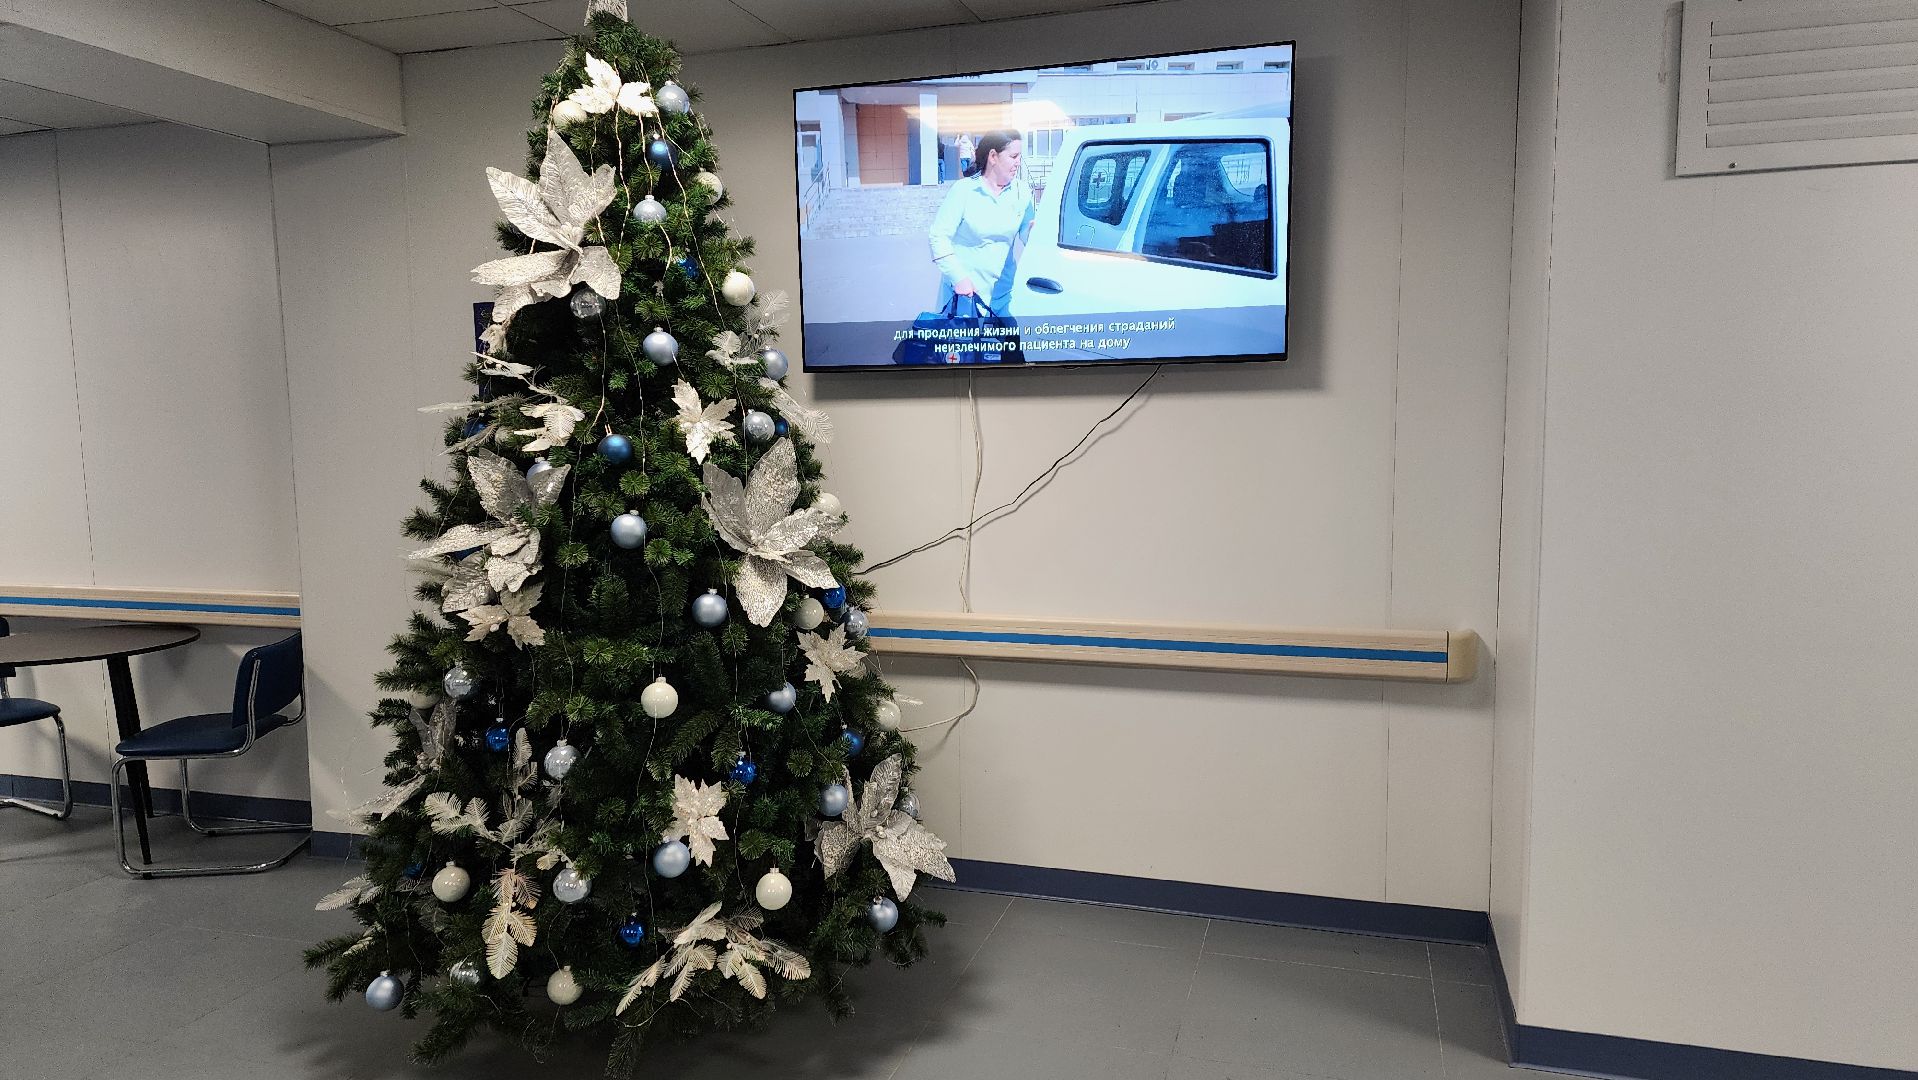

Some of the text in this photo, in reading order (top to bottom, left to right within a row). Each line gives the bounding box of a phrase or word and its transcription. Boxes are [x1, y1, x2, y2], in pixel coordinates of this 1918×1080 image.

[894, 317, 1176, 341] для продления жизни и облегчения страданий
[934, 337, 1132, 353] неизлечимого пациента на дому
